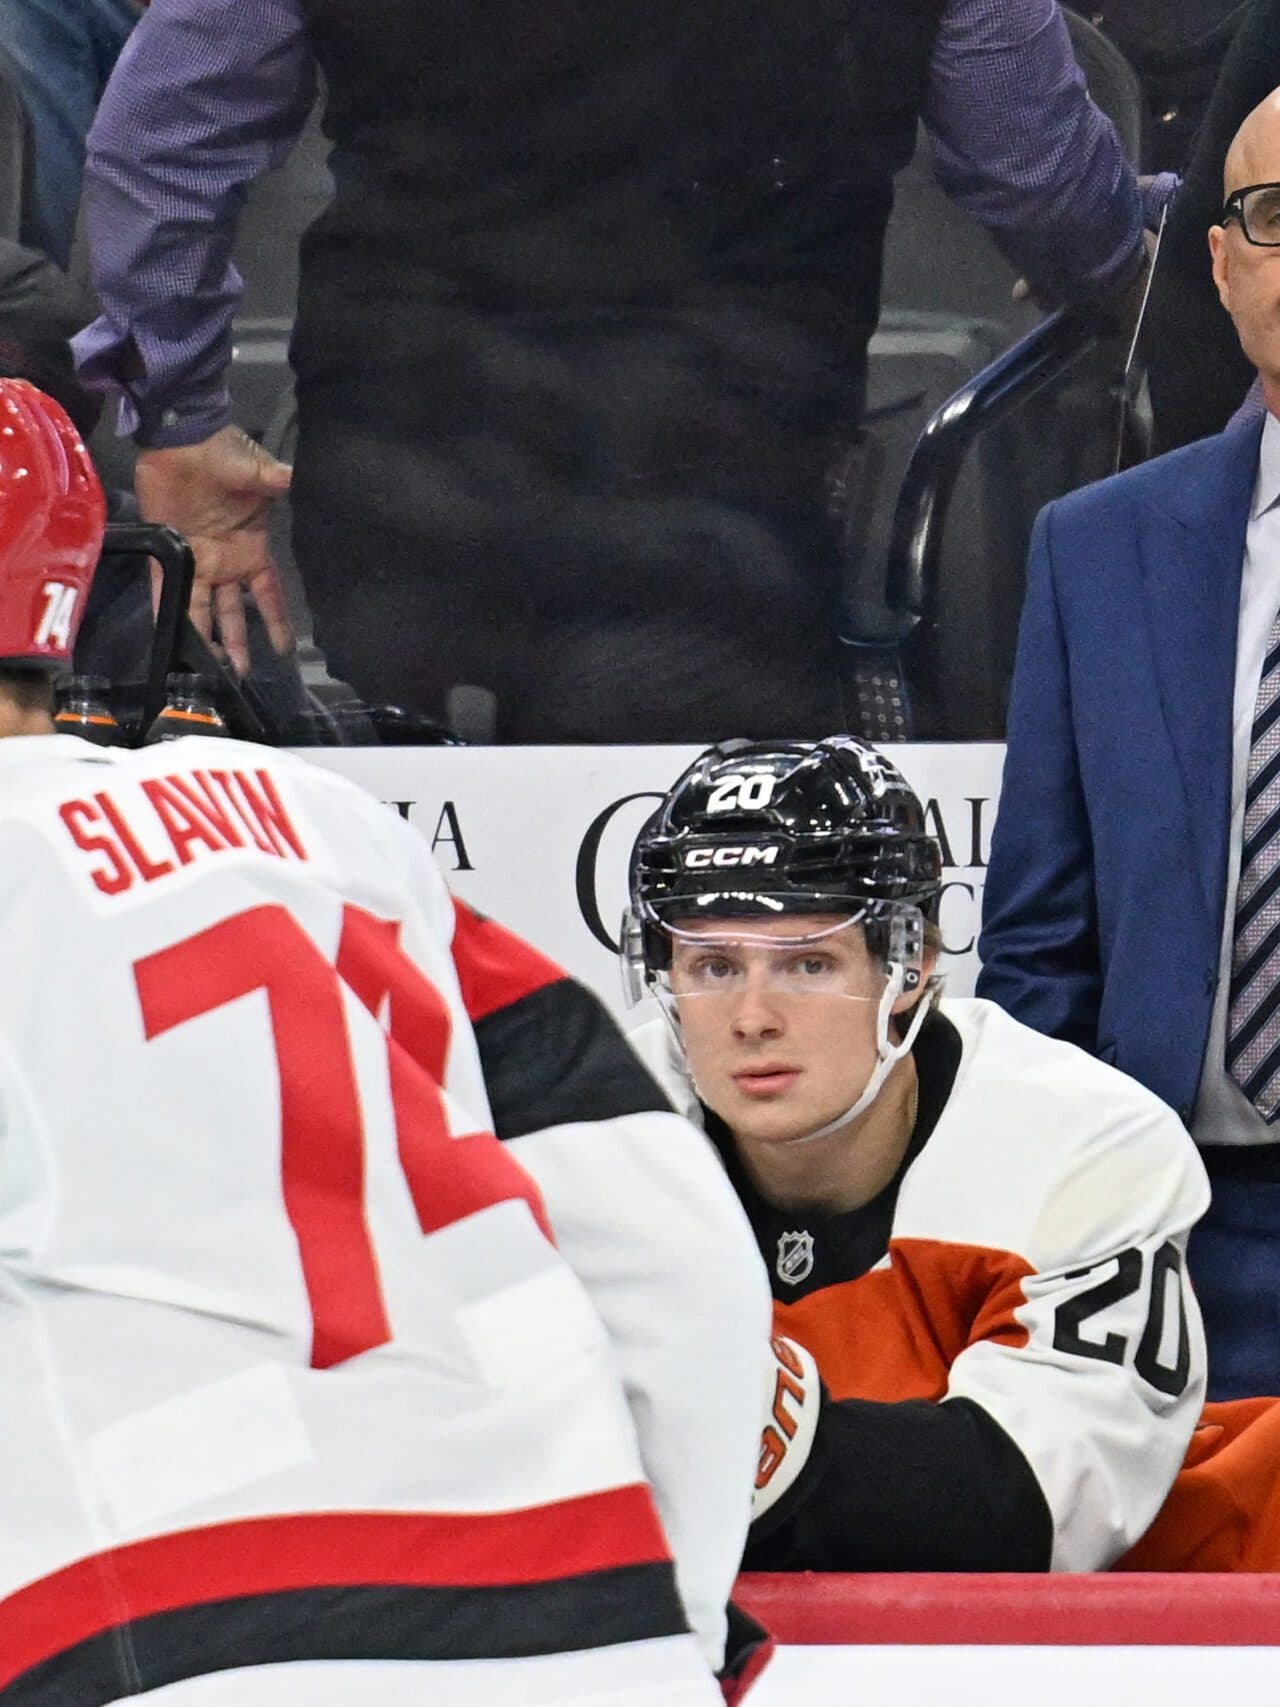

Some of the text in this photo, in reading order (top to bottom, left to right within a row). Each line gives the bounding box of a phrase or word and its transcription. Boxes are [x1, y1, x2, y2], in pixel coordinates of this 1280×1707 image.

[34, 582, 78, 650] 74
[706, 774, 777, 814] 20
[685, 846, 779, 867] CCM
[1051, 1240, 1191, 1397] 20
